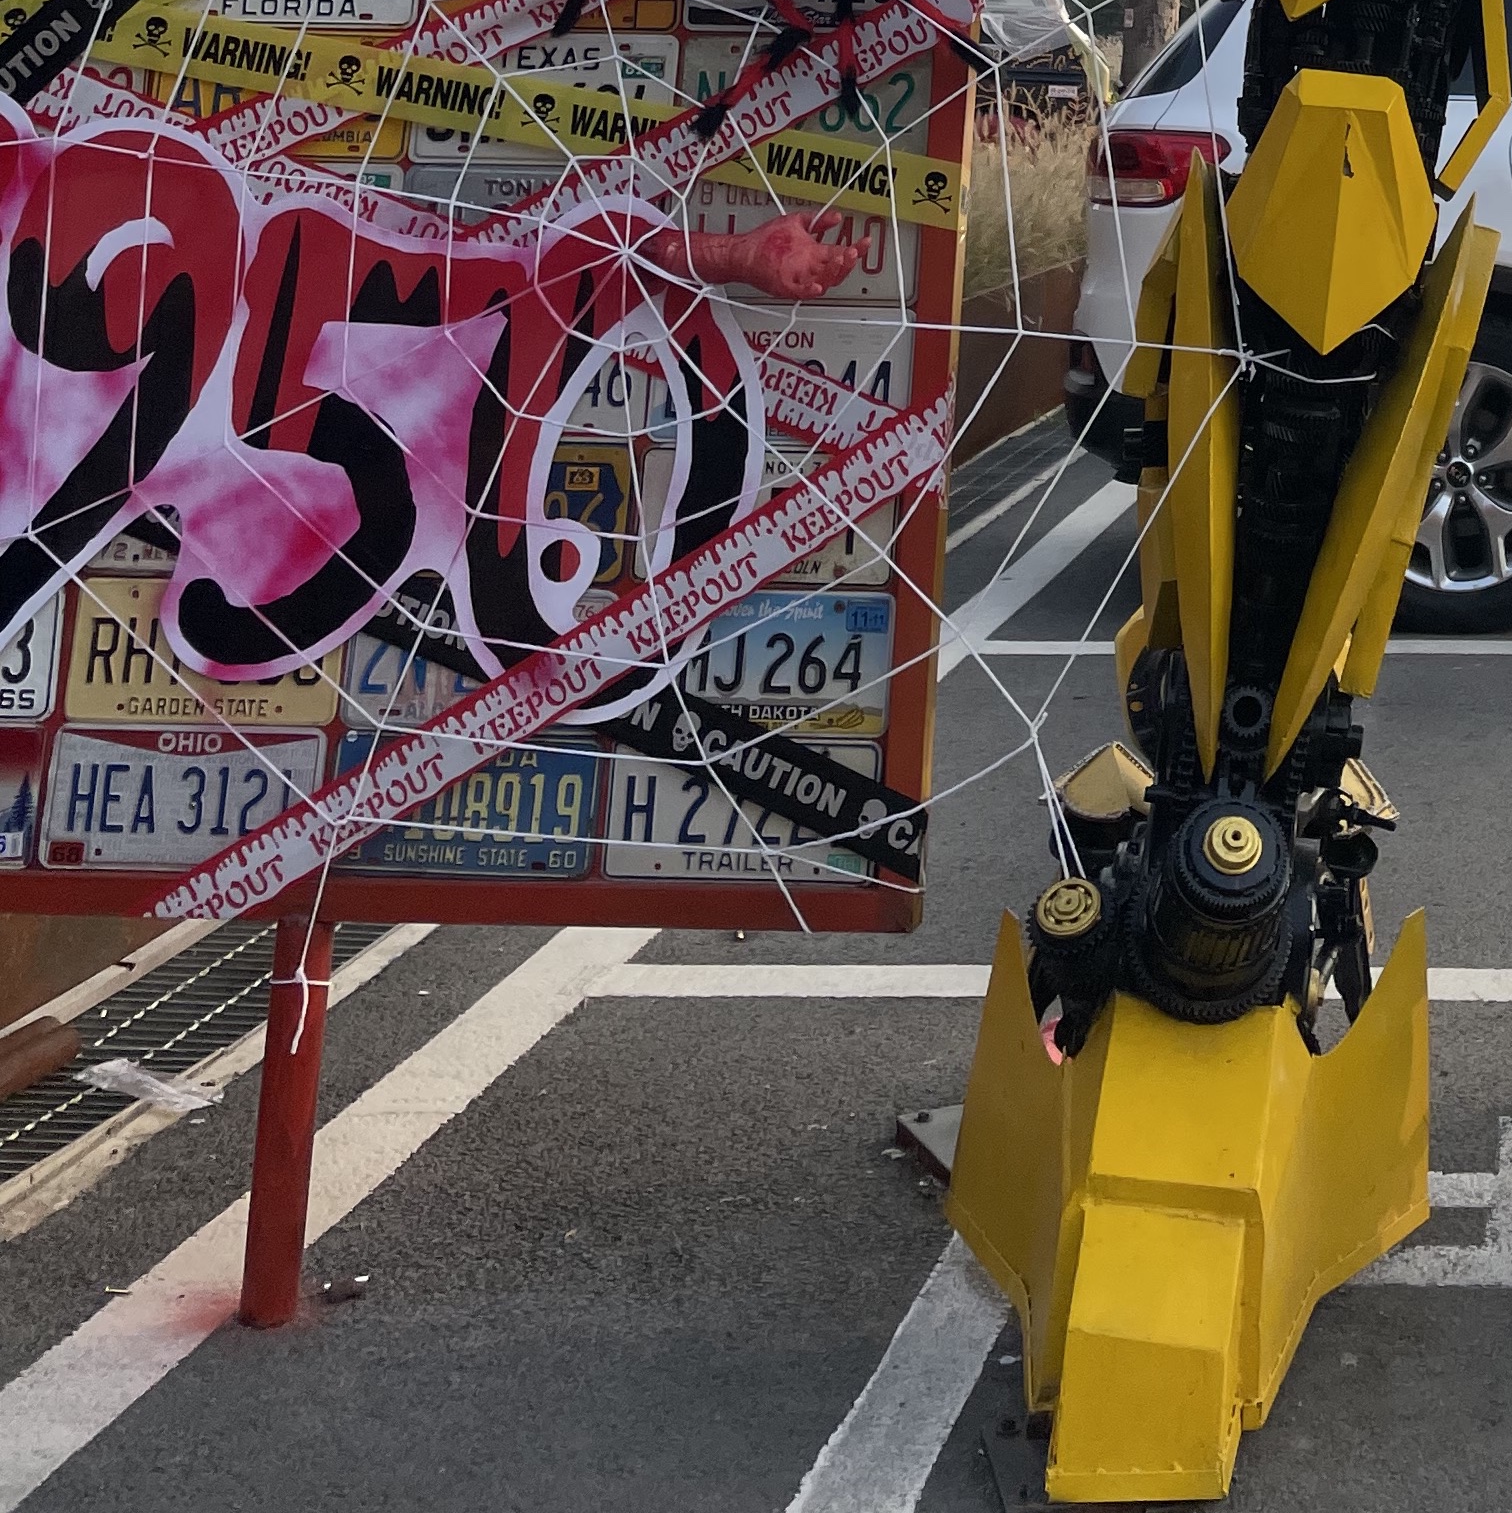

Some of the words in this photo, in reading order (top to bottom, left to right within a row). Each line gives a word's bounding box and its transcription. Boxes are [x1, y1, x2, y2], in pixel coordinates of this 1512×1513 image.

[182, 26, 313, 82] WARNING!
[375, 64, 506, 122] WARNING!
[766, 142, 898, 201] WARNING!
[761, 632, 864, 696] 264
[128, 697, 205, 717] GARDEN
[214, 697, 270, 717] STATE
[749, 704, 820, 722] DAKOTA
[157, 732, 223, 755] OHIO
[702, 729, 848, 819] CAUTION
[66, 763, 156, 834] HEA
[383, 843, 466, 866] SUNSHINE
[477, 847, 527, 868] STATE
[682, 850, 793, 874] TRAILER
